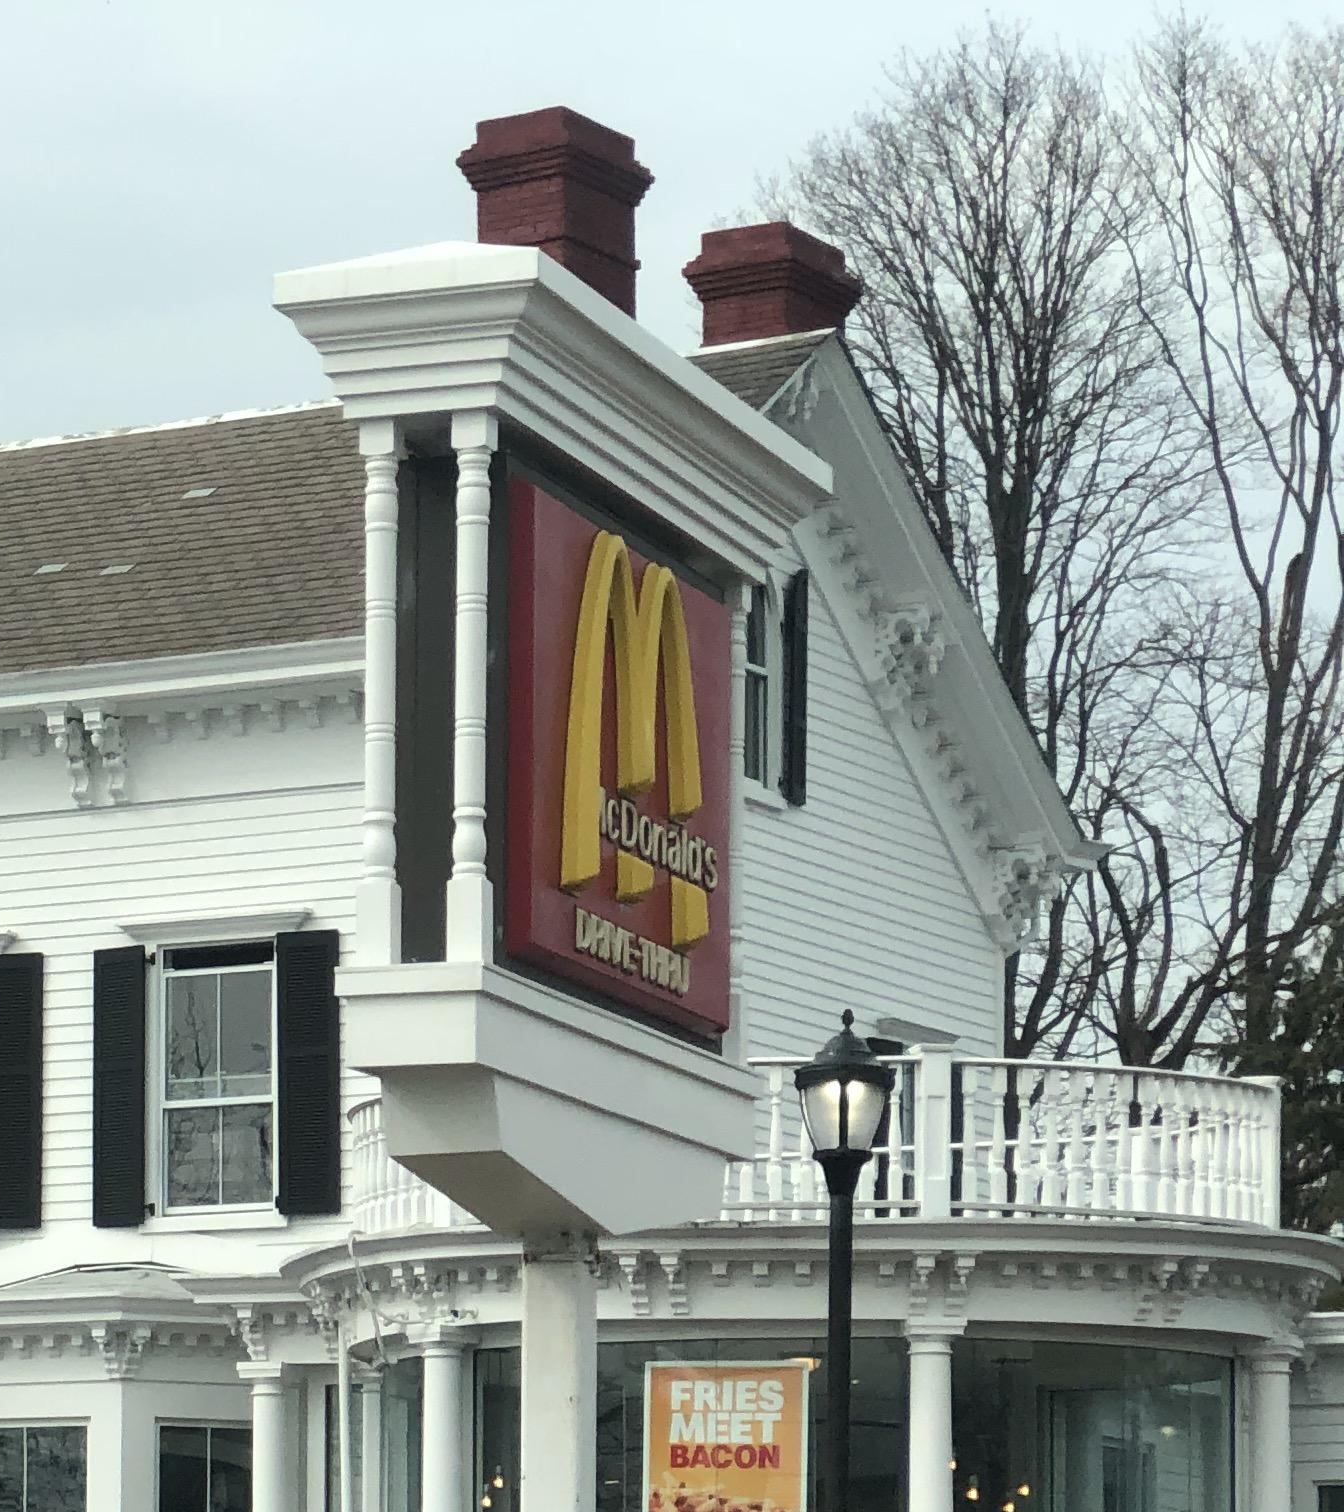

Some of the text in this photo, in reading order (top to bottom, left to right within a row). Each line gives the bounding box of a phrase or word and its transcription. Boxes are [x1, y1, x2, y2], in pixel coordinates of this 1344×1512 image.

[575, 907, 691, 994] DRIVE-THRU
[670, 1380, 784, 1412] FRIES
[669, 1412, 781, 1444] MEET
[670, 1444, 780, 1469] BACON
